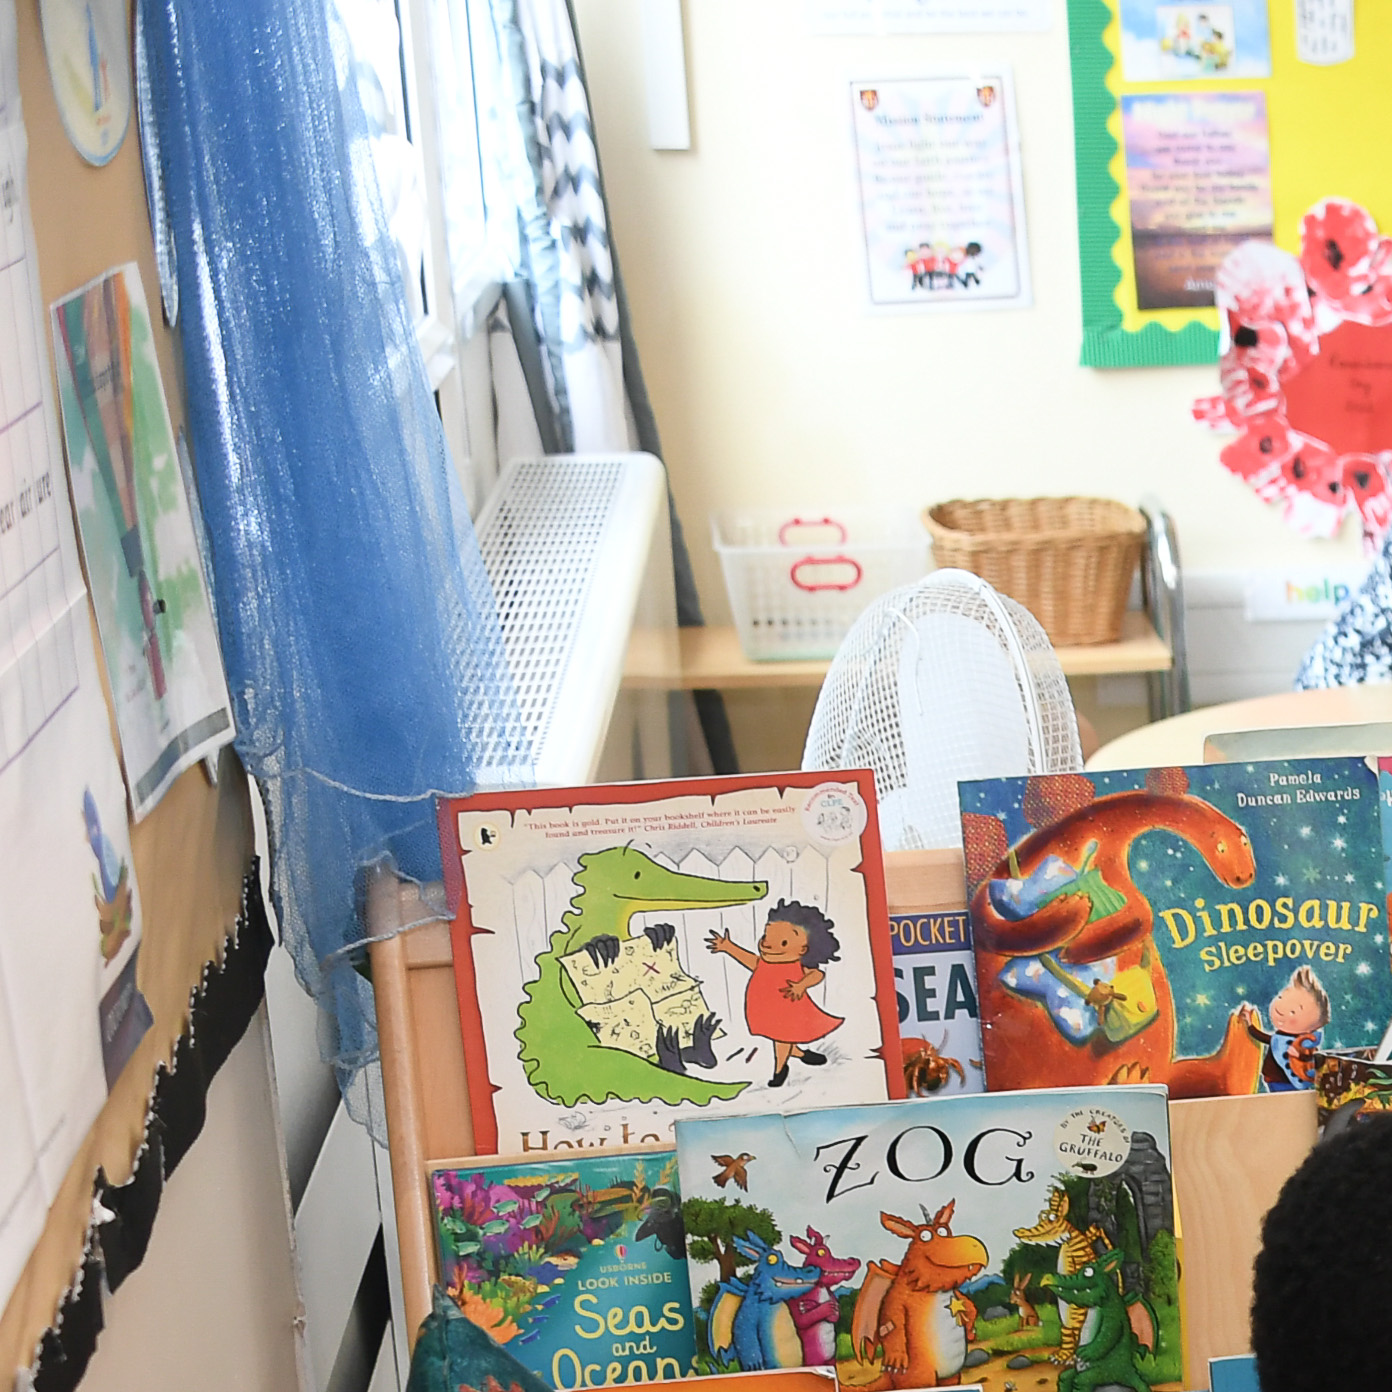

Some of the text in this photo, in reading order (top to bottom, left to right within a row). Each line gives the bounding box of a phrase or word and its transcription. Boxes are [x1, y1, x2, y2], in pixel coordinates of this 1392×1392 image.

[1287, 577, 1349, 606] help
[1269, 770, 1322, 786] Pamela
[1237, 786, 1361, 807] Duncan Edwards
[549, 820, 569, 829] book
[605, 817, 619, 826] Put
[664, 811, 705, 821] bookshelf
[707, 810, 732, 818] where
[772, 806, 796, 814] easily
[545, 830, 570, 839] found
[572, 829, 588, 837] and
[590, 827, 625, 836] treasure
[644, 824, 665, 832] Chris
[889, 916, 967, 947] POCKET
[1159, 897, 1379, 949] Dinosaur
[1200, 938, 1352, 972] Sleepover
[1080, 1133, 1104, 1147] THE
[1059, 1142, 1123, 1163] GRUFFALO
[813, 1125, 1035, 1204] ZOG
[599, 1262, 647, 1273] USBORNE
[578, 1272, 672, 1290] LOOK INSIDE
[574, 1294, 685, 1339] Seas
[613, 1335, 657, 1357] and
